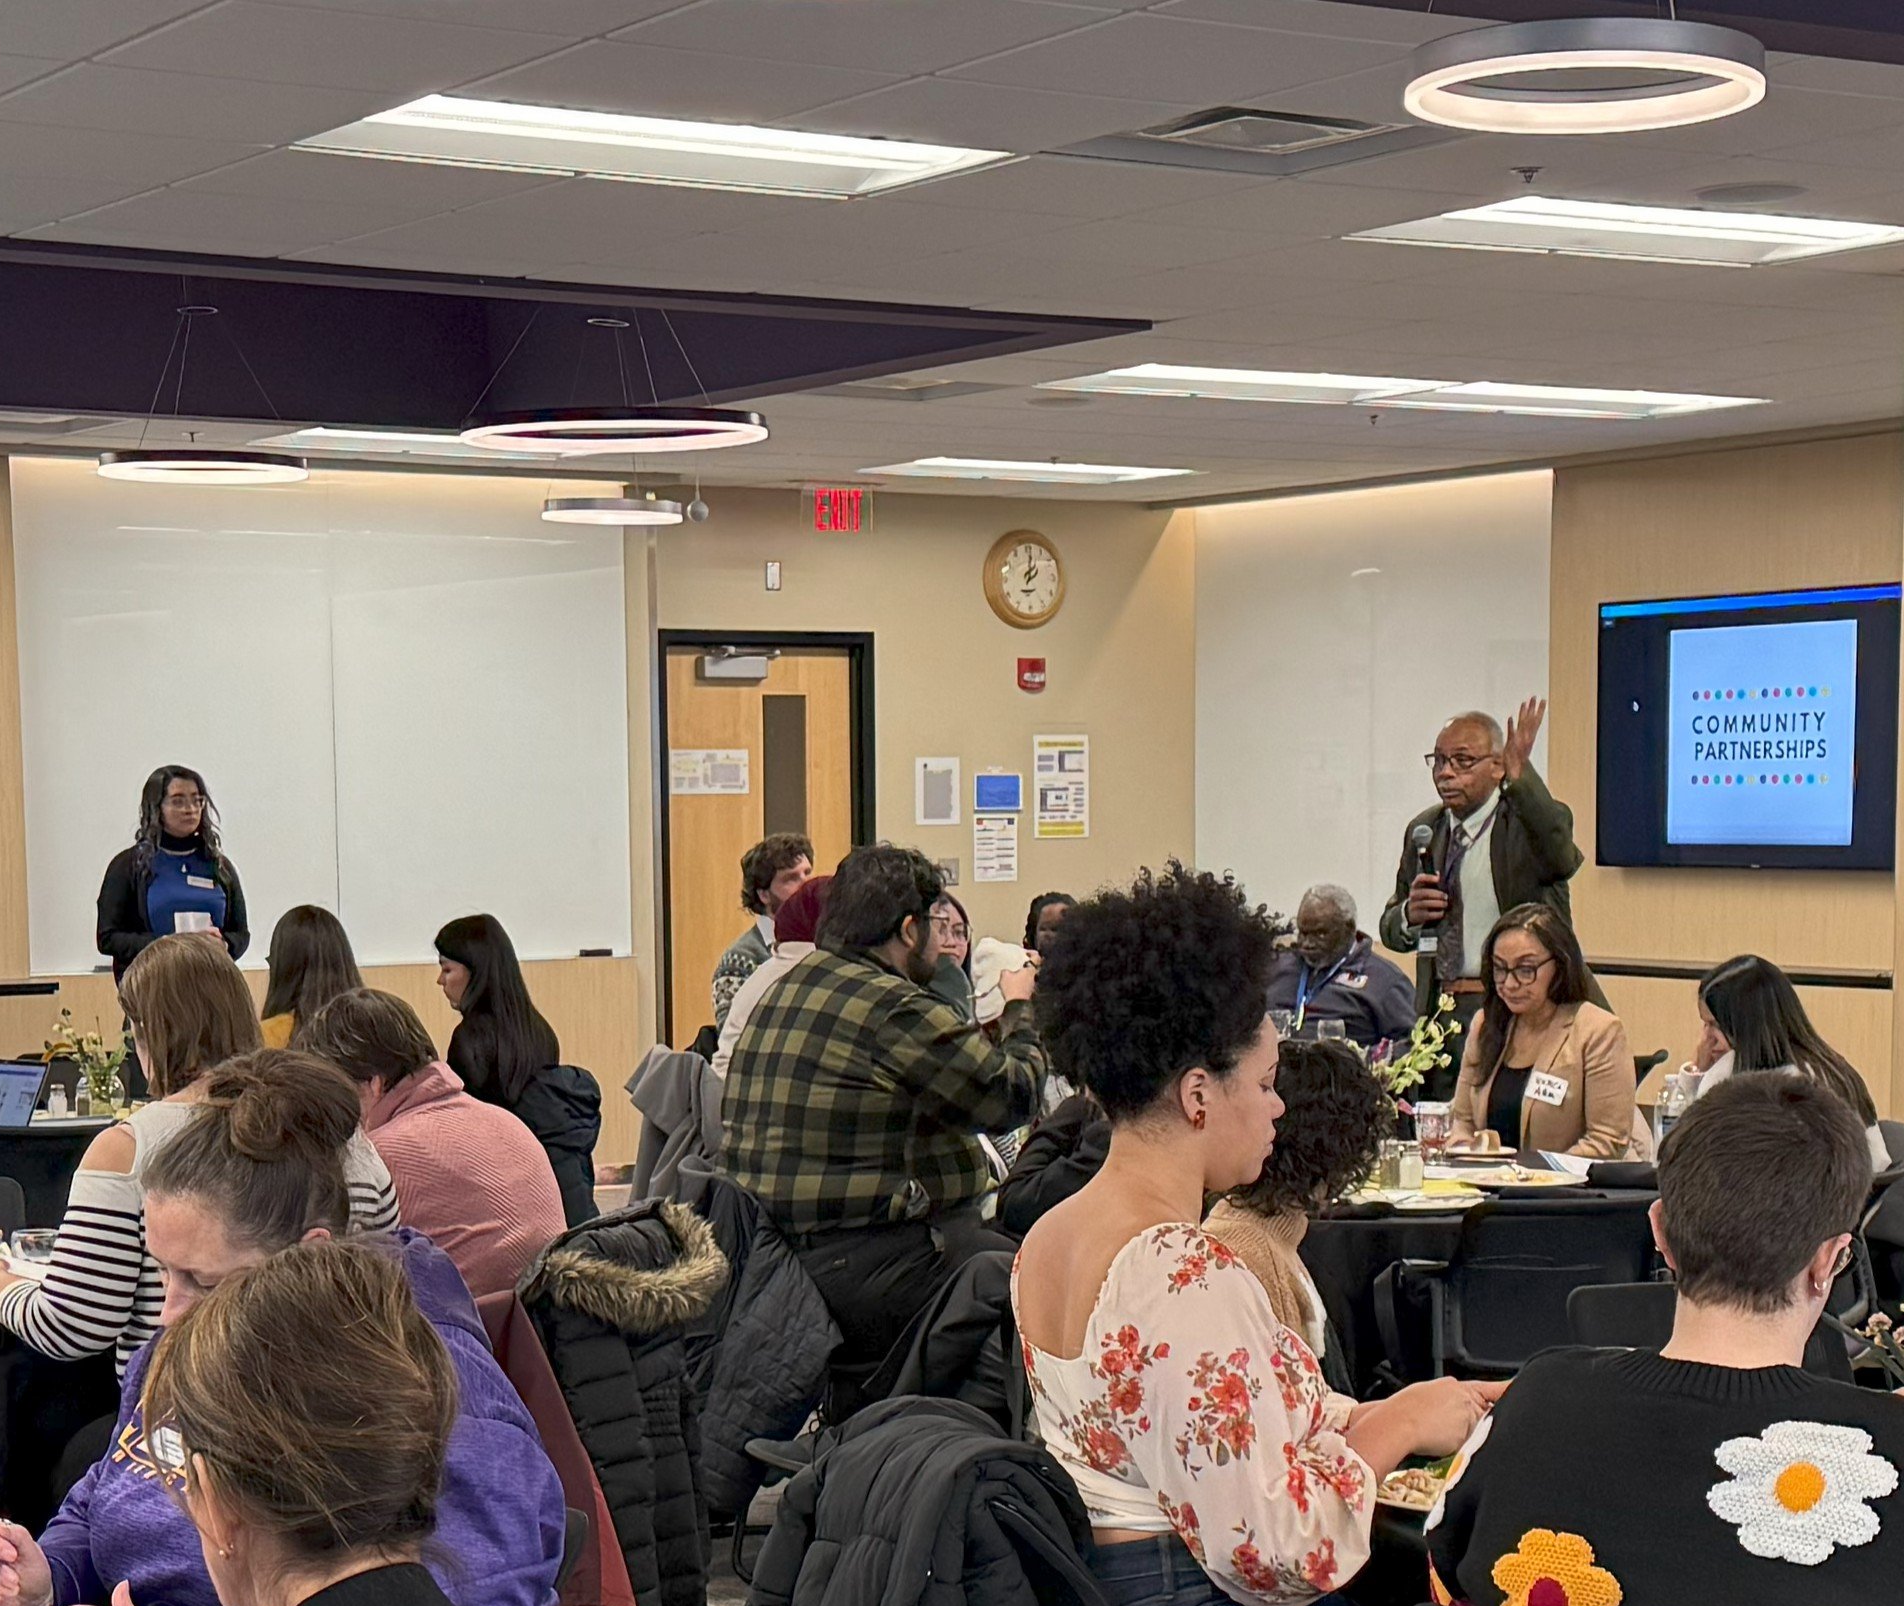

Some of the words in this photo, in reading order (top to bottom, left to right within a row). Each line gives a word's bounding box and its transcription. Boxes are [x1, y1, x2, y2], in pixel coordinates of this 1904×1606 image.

[815, 487, 863, 532] EXIT
[1691, 711, 1826, 735] COMMUNITY
[1694, 739, 1827, 761] PARTNERSHIPS
